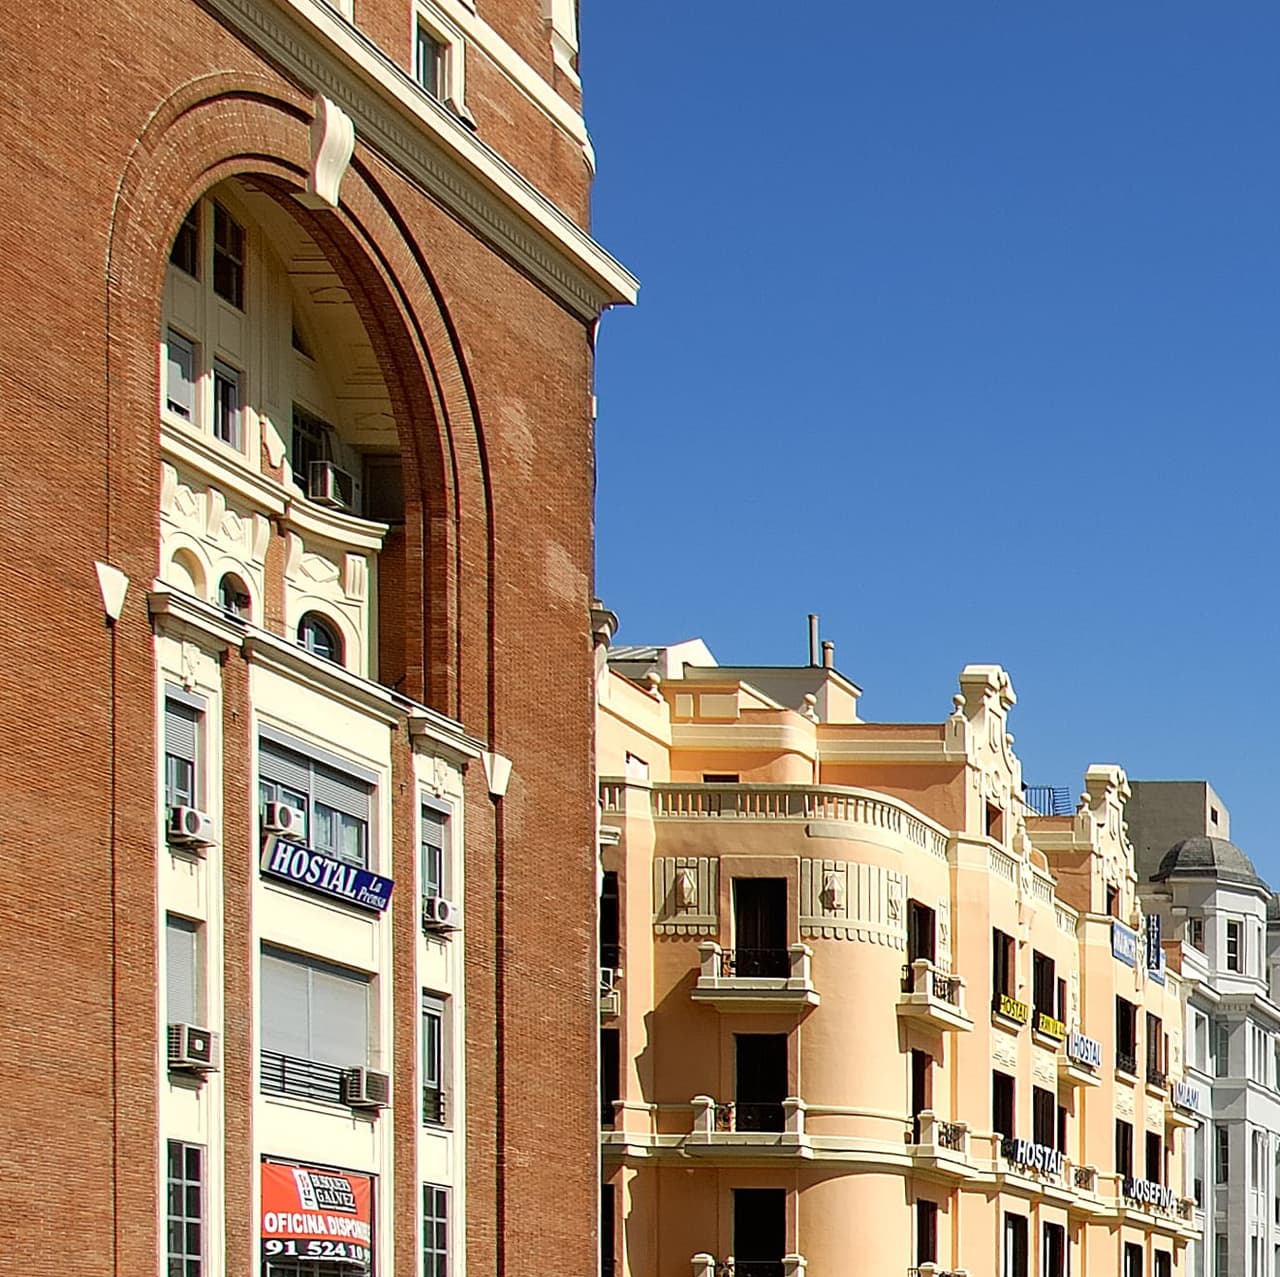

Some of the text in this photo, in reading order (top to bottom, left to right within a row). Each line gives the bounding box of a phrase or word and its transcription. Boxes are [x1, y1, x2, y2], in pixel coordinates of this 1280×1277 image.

[271, 842, 358, 899] HOSTAL
[369, 876, 382, 893] La
[357, 886, 386, 909] Prensa
[1073, 1033, 1199, 1108] HOSTAL MIAMI
[1016, 1139, 1175, 1206] HOSTAL JOSEFINA
[315, 1188, 356, 1208] GALVEZ
[264, 1212, 328, 1236] OFICINA
[265, 1240, 298, 1256] 91
[307, 1241, 347, 1257] 524
[348, 1244, 363, 1260] 10
